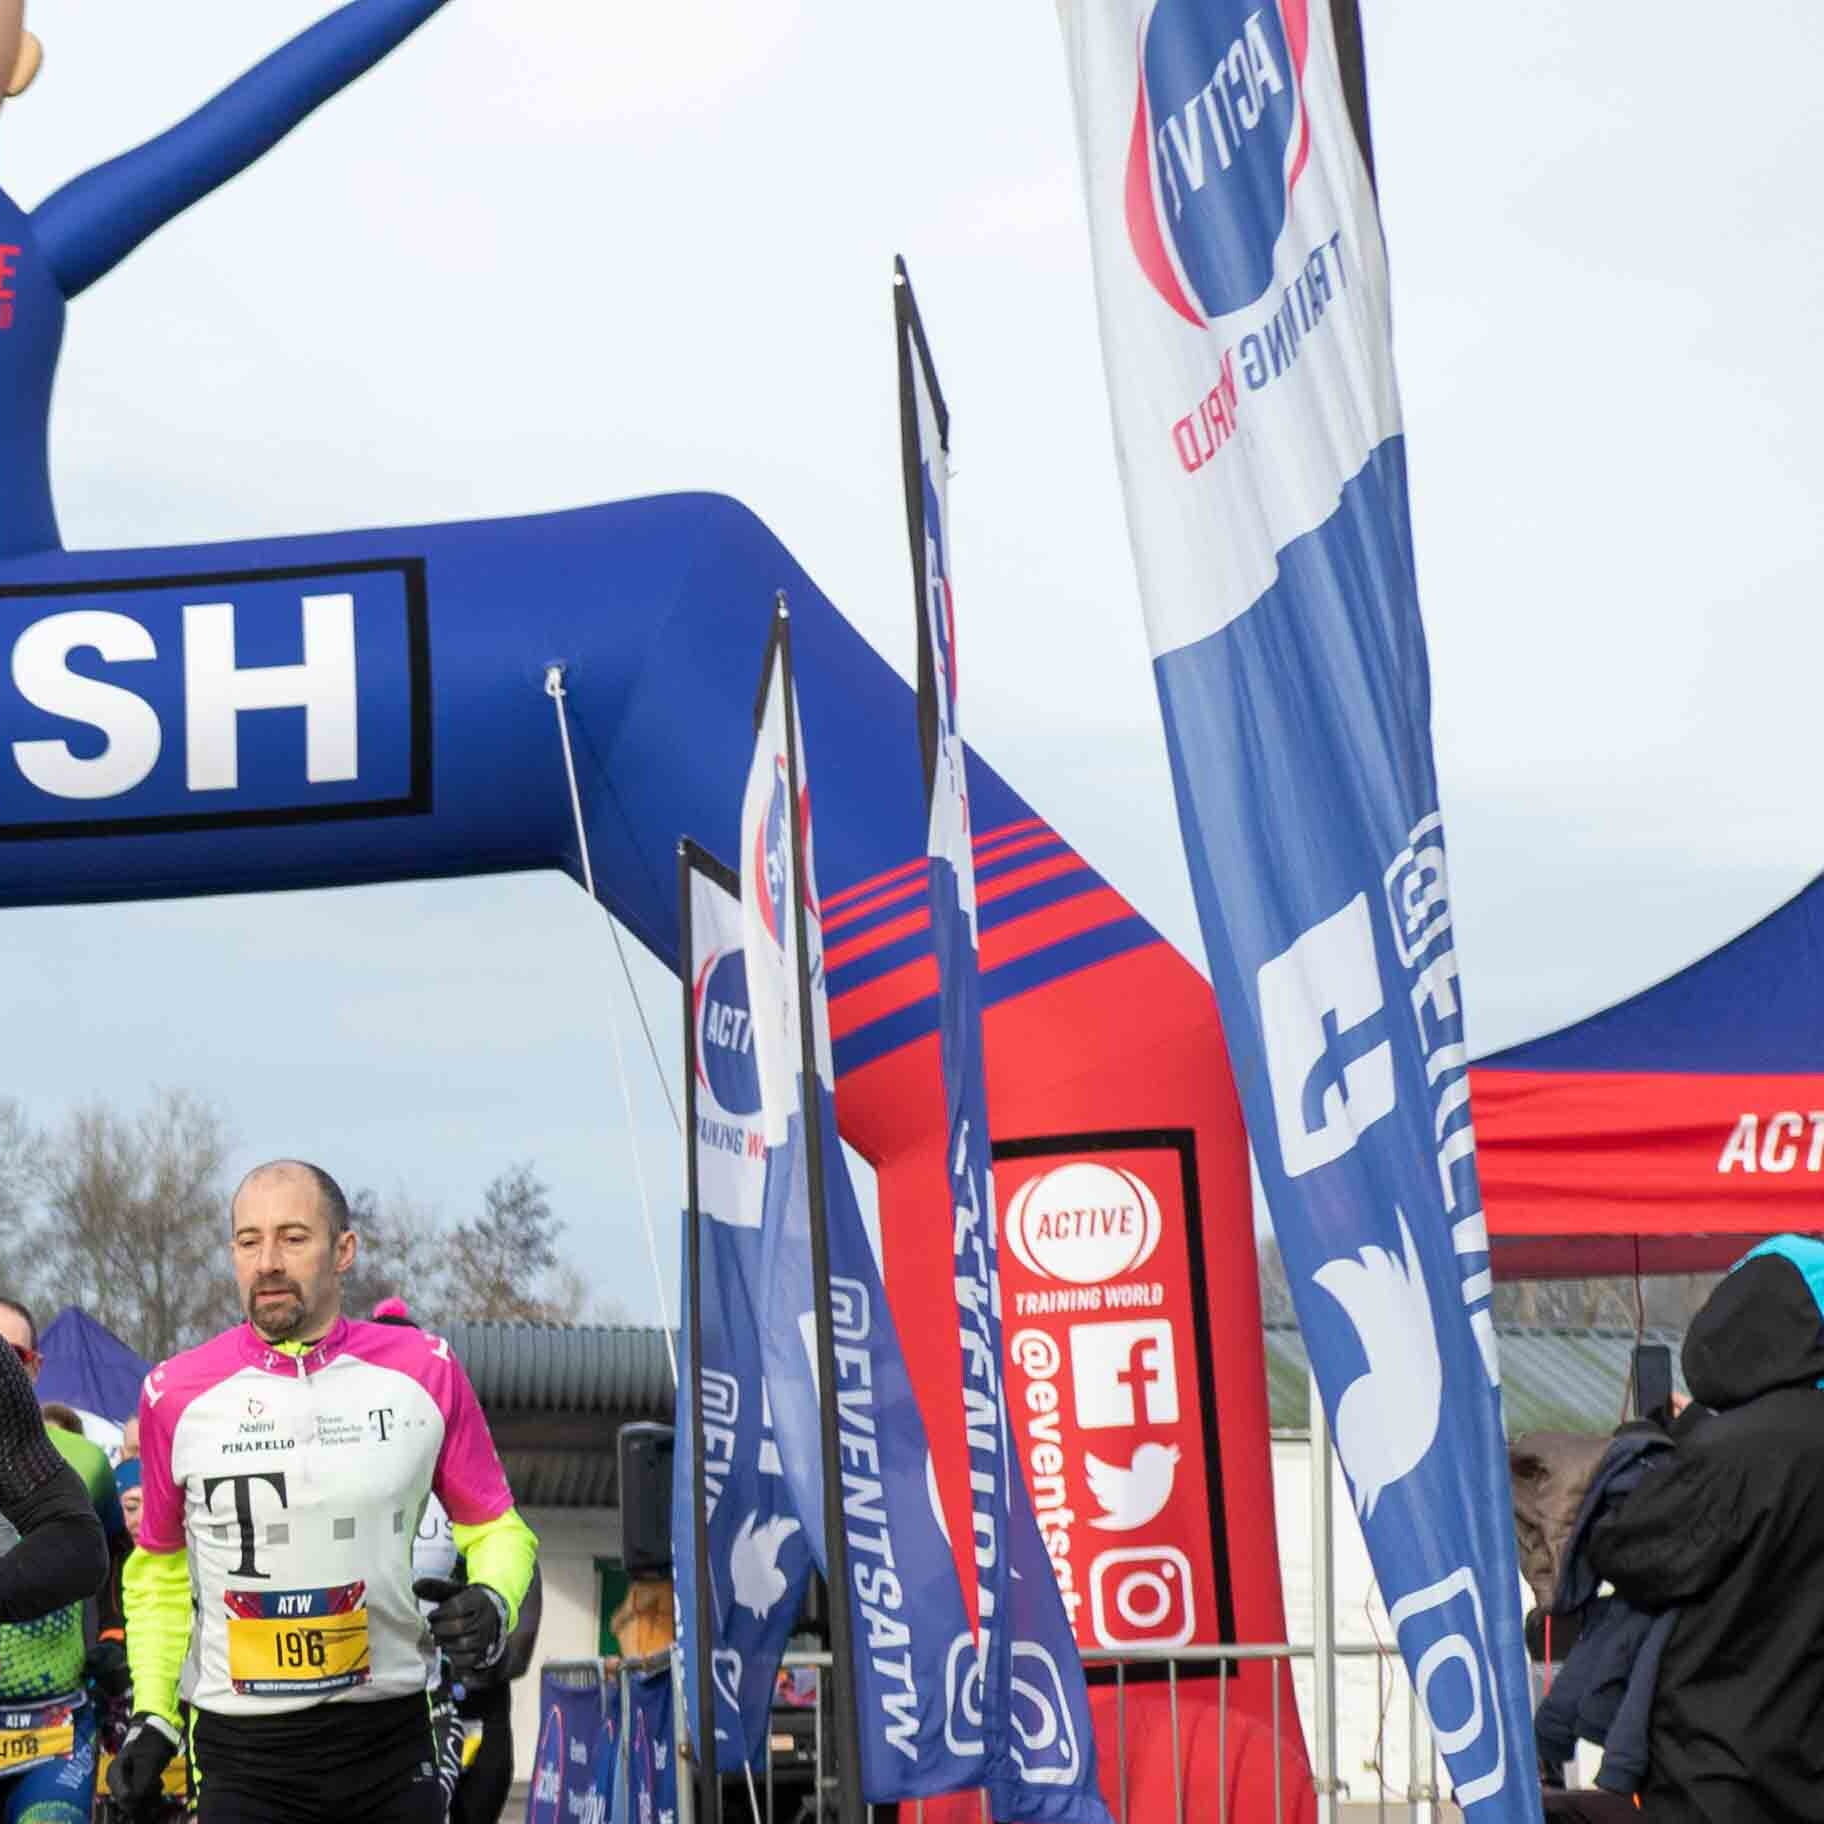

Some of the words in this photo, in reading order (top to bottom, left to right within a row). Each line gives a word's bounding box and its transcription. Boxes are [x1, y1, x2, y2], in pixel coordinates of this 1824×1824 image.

[1036, 1205, 1134, 1240] ACTIVE
[1015, 1286, 1101, 1315] TRAINING
[1104, 1283, 1164, 1307] WORLD
[239, 1419, 274, 1433] Nalini
[368, 1407, 394, 1442] T
[221, 1438, 295, 1455] PINARELLO
[202, 1471, 288, 1579] T
[278, 1594, 312, 1615] ATW
[276, 1630, 326, 1668] 196
